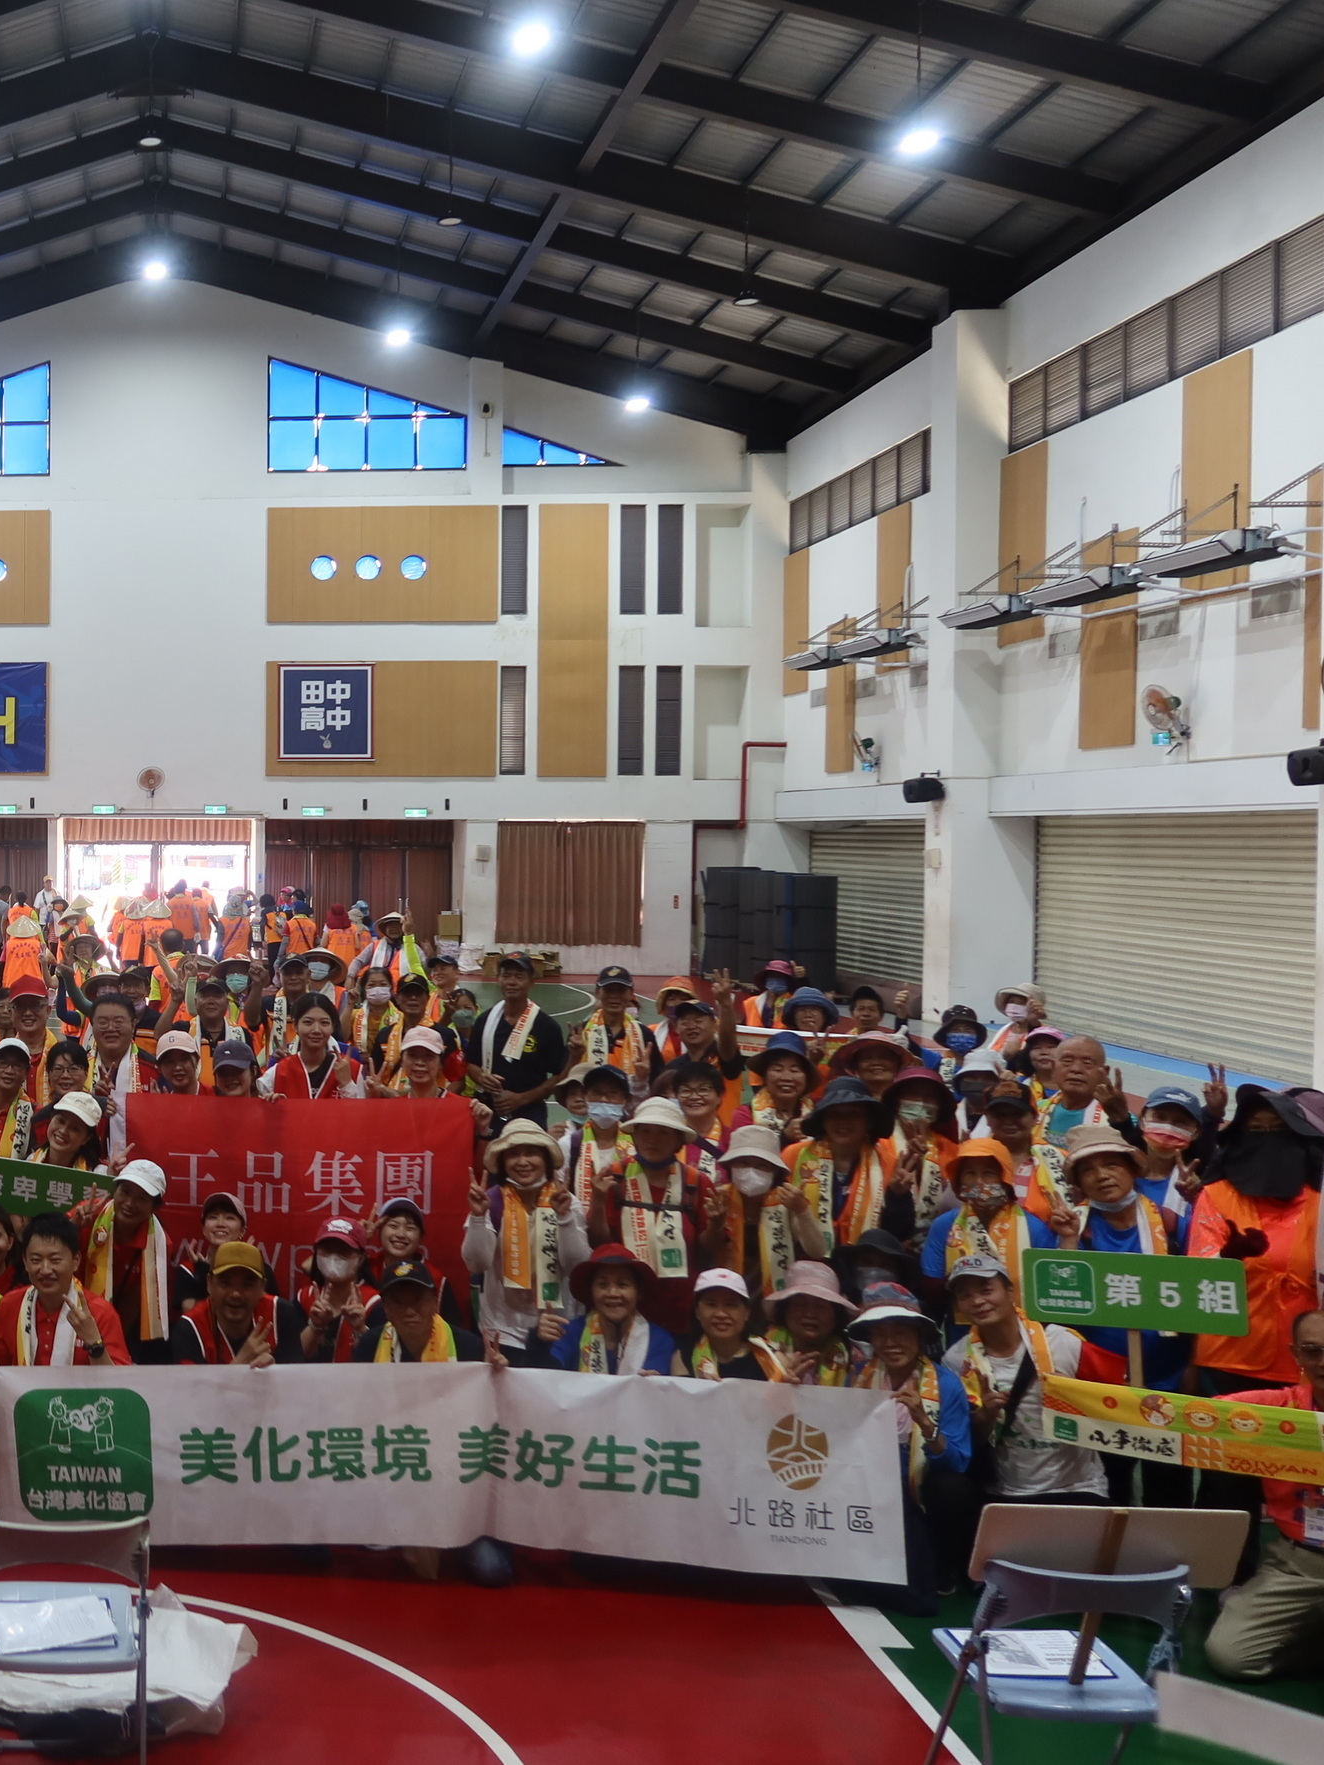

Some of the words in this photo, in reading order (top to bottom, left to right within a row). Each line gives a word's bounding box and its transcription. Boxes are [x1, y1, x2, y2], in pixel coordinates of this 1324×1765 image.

[301, 680, 351, 705] 田中
[301, 706, 351, 731] 高中
[166, 1149, 434, 1216] 王品集團
[1089, 1429, 1176, 1457] 凡事徹底
[178, 1424, 433, 1487] 美化環境
[457, 1422, 702, 1500] 美好生活
[47, 1465, 122, 1484] TAIWAN
[26, 1490, 147, 1513] 台灣美化協會
[729, 1497, 875, 1534] 北路社區
[770, 1534, 827, 1546] TIANZHONG
